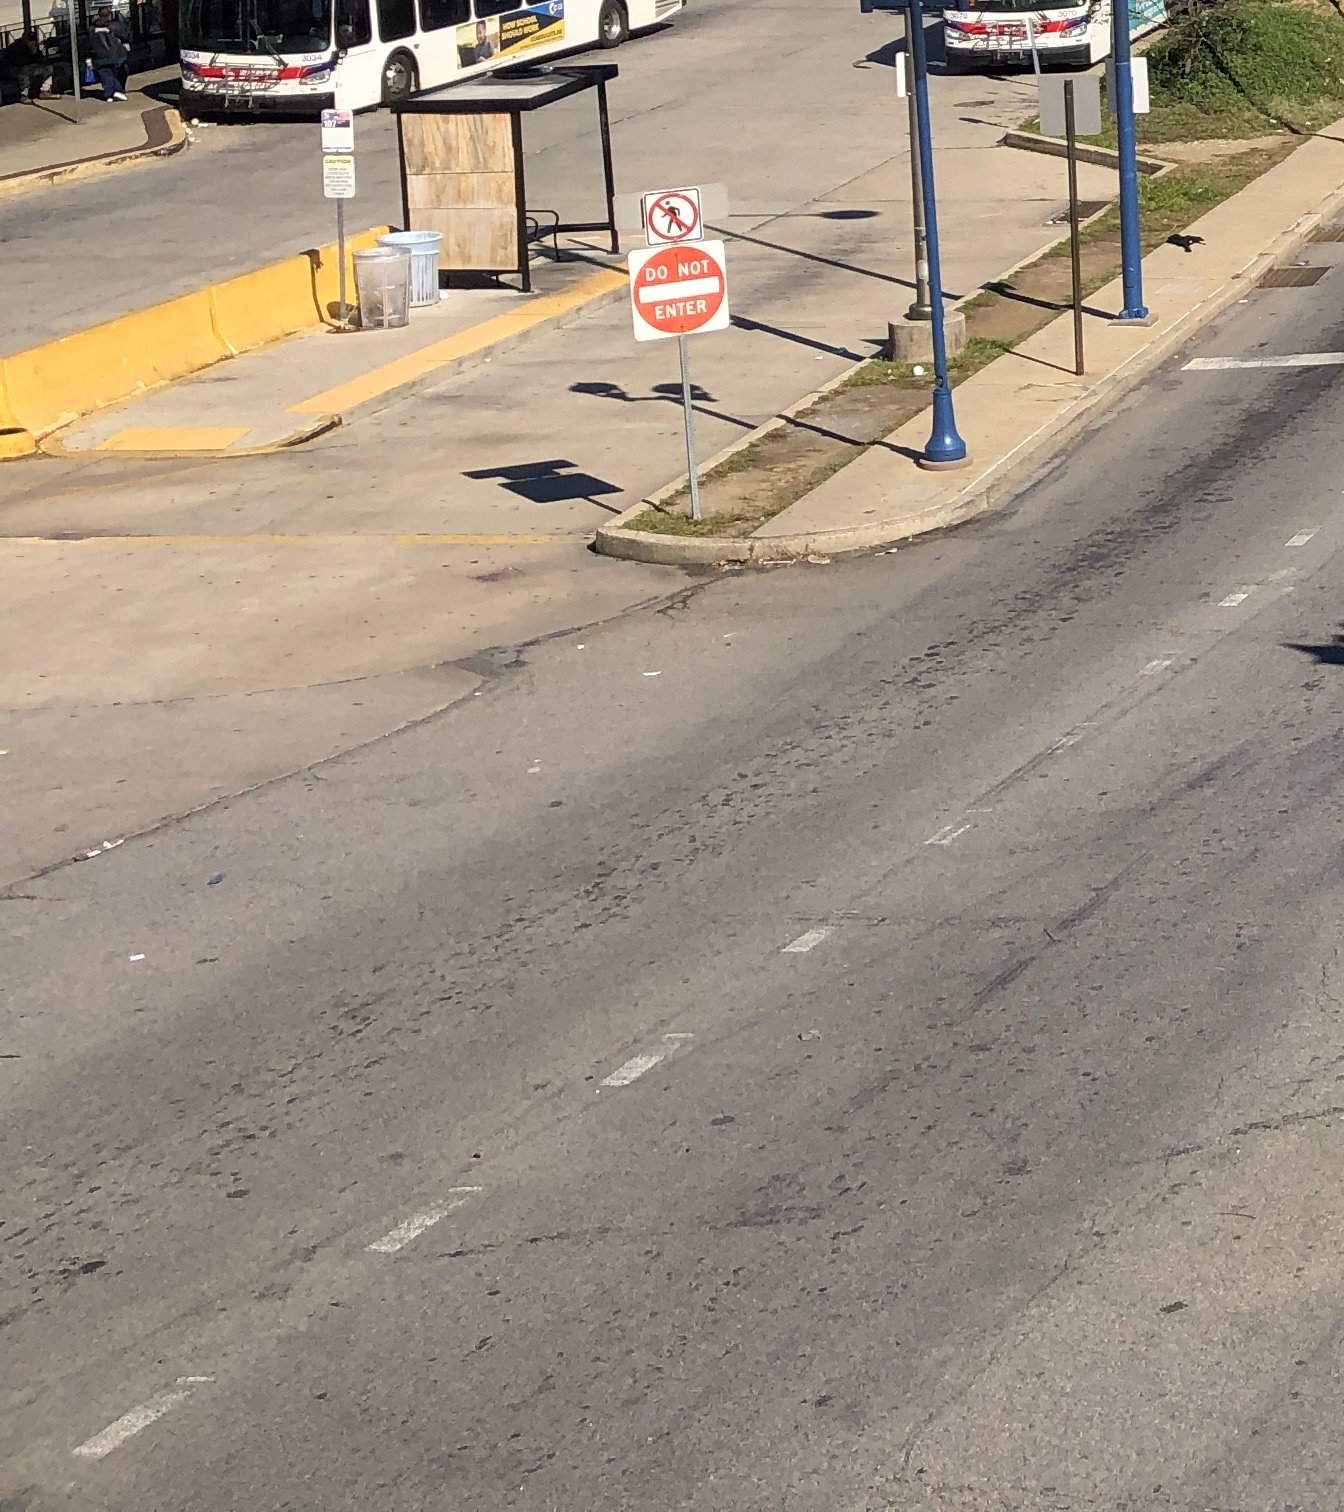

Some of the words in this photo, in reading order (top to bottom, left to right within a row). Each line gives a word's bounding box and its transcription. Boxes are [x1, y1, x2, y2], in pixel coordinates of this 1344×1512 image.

[1057, 10, 1078, 18] 3070
[301, 54, 323, 63] 3034
[645, 265, 668, 282] DO
[677, 260, 710, 278] NOT
[654, 300, 707, 320] ENTER
